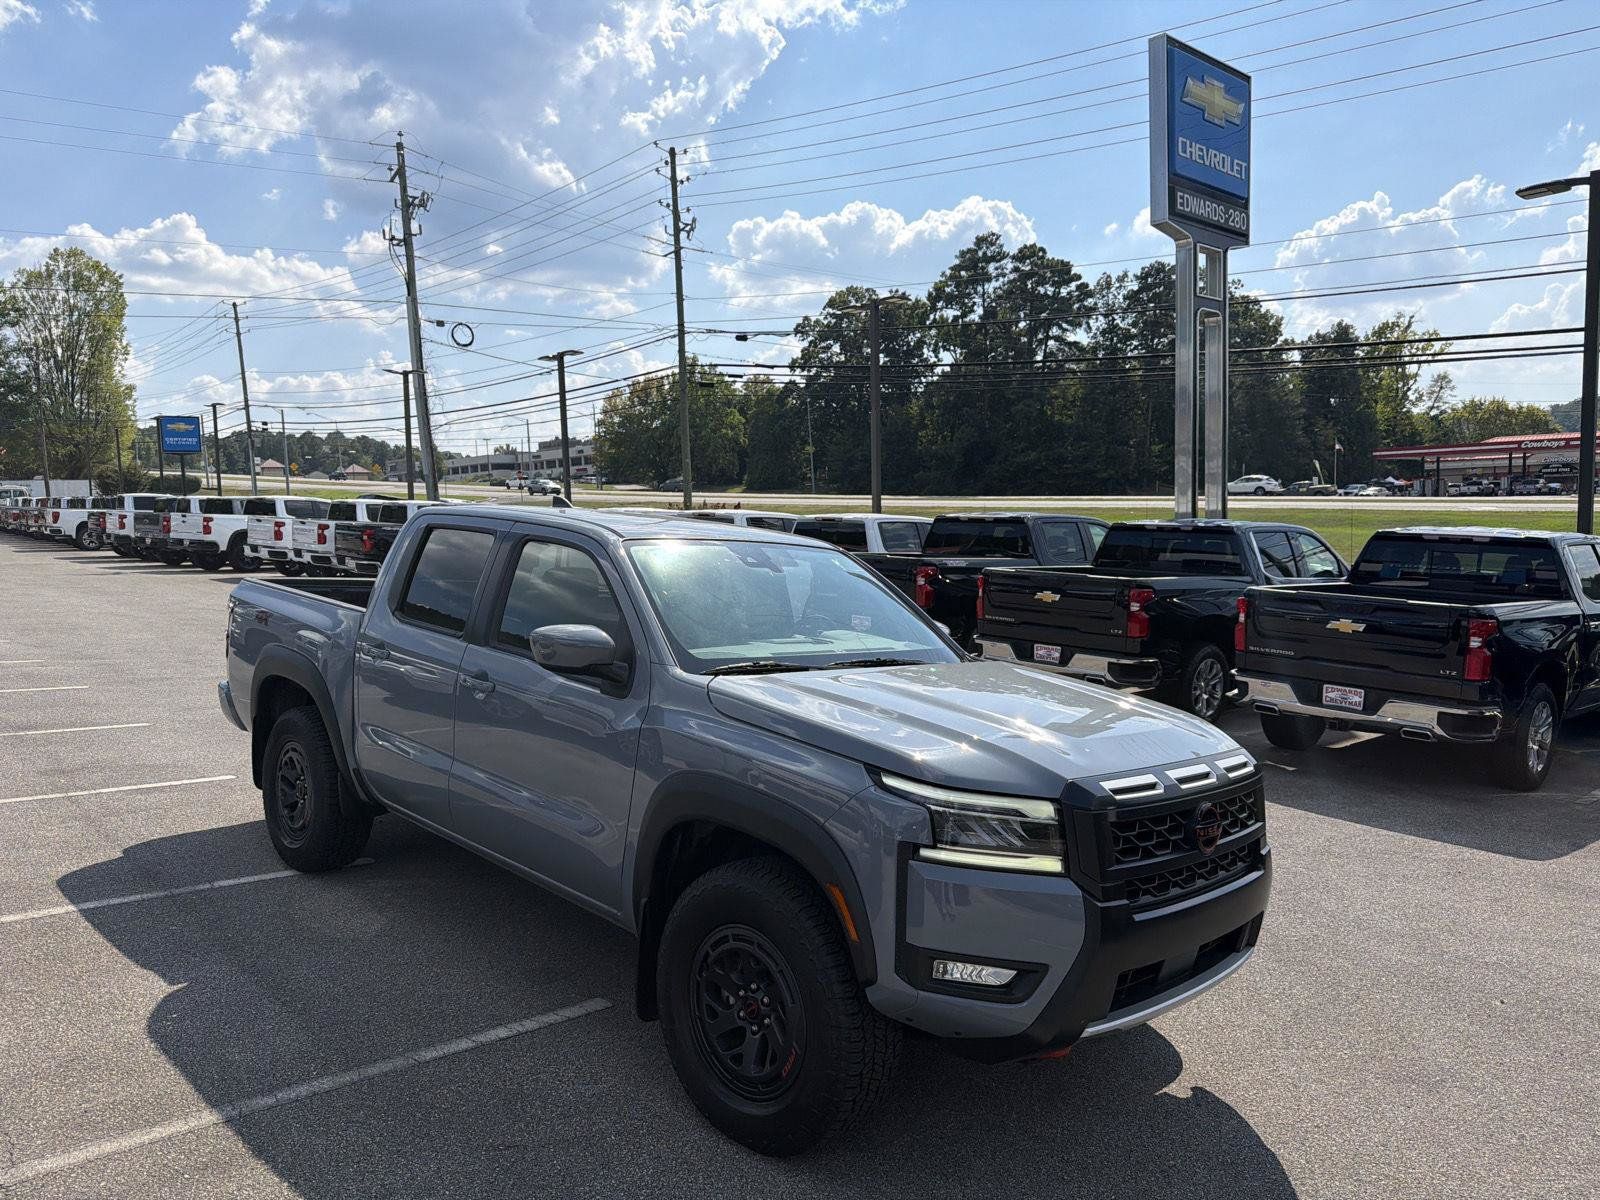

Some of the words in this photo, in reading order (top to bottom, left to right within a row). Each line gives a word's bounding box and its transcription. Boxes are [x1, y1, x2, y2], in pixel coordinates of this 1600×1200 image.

[1178, 137, 1247, 179] CHEVROLET
[1521, 440, 1566, 448] Cowboys
[1248, 645, 1295, 656] SILVERADO
[1325, 686, 1363, 698] EDWARDS
